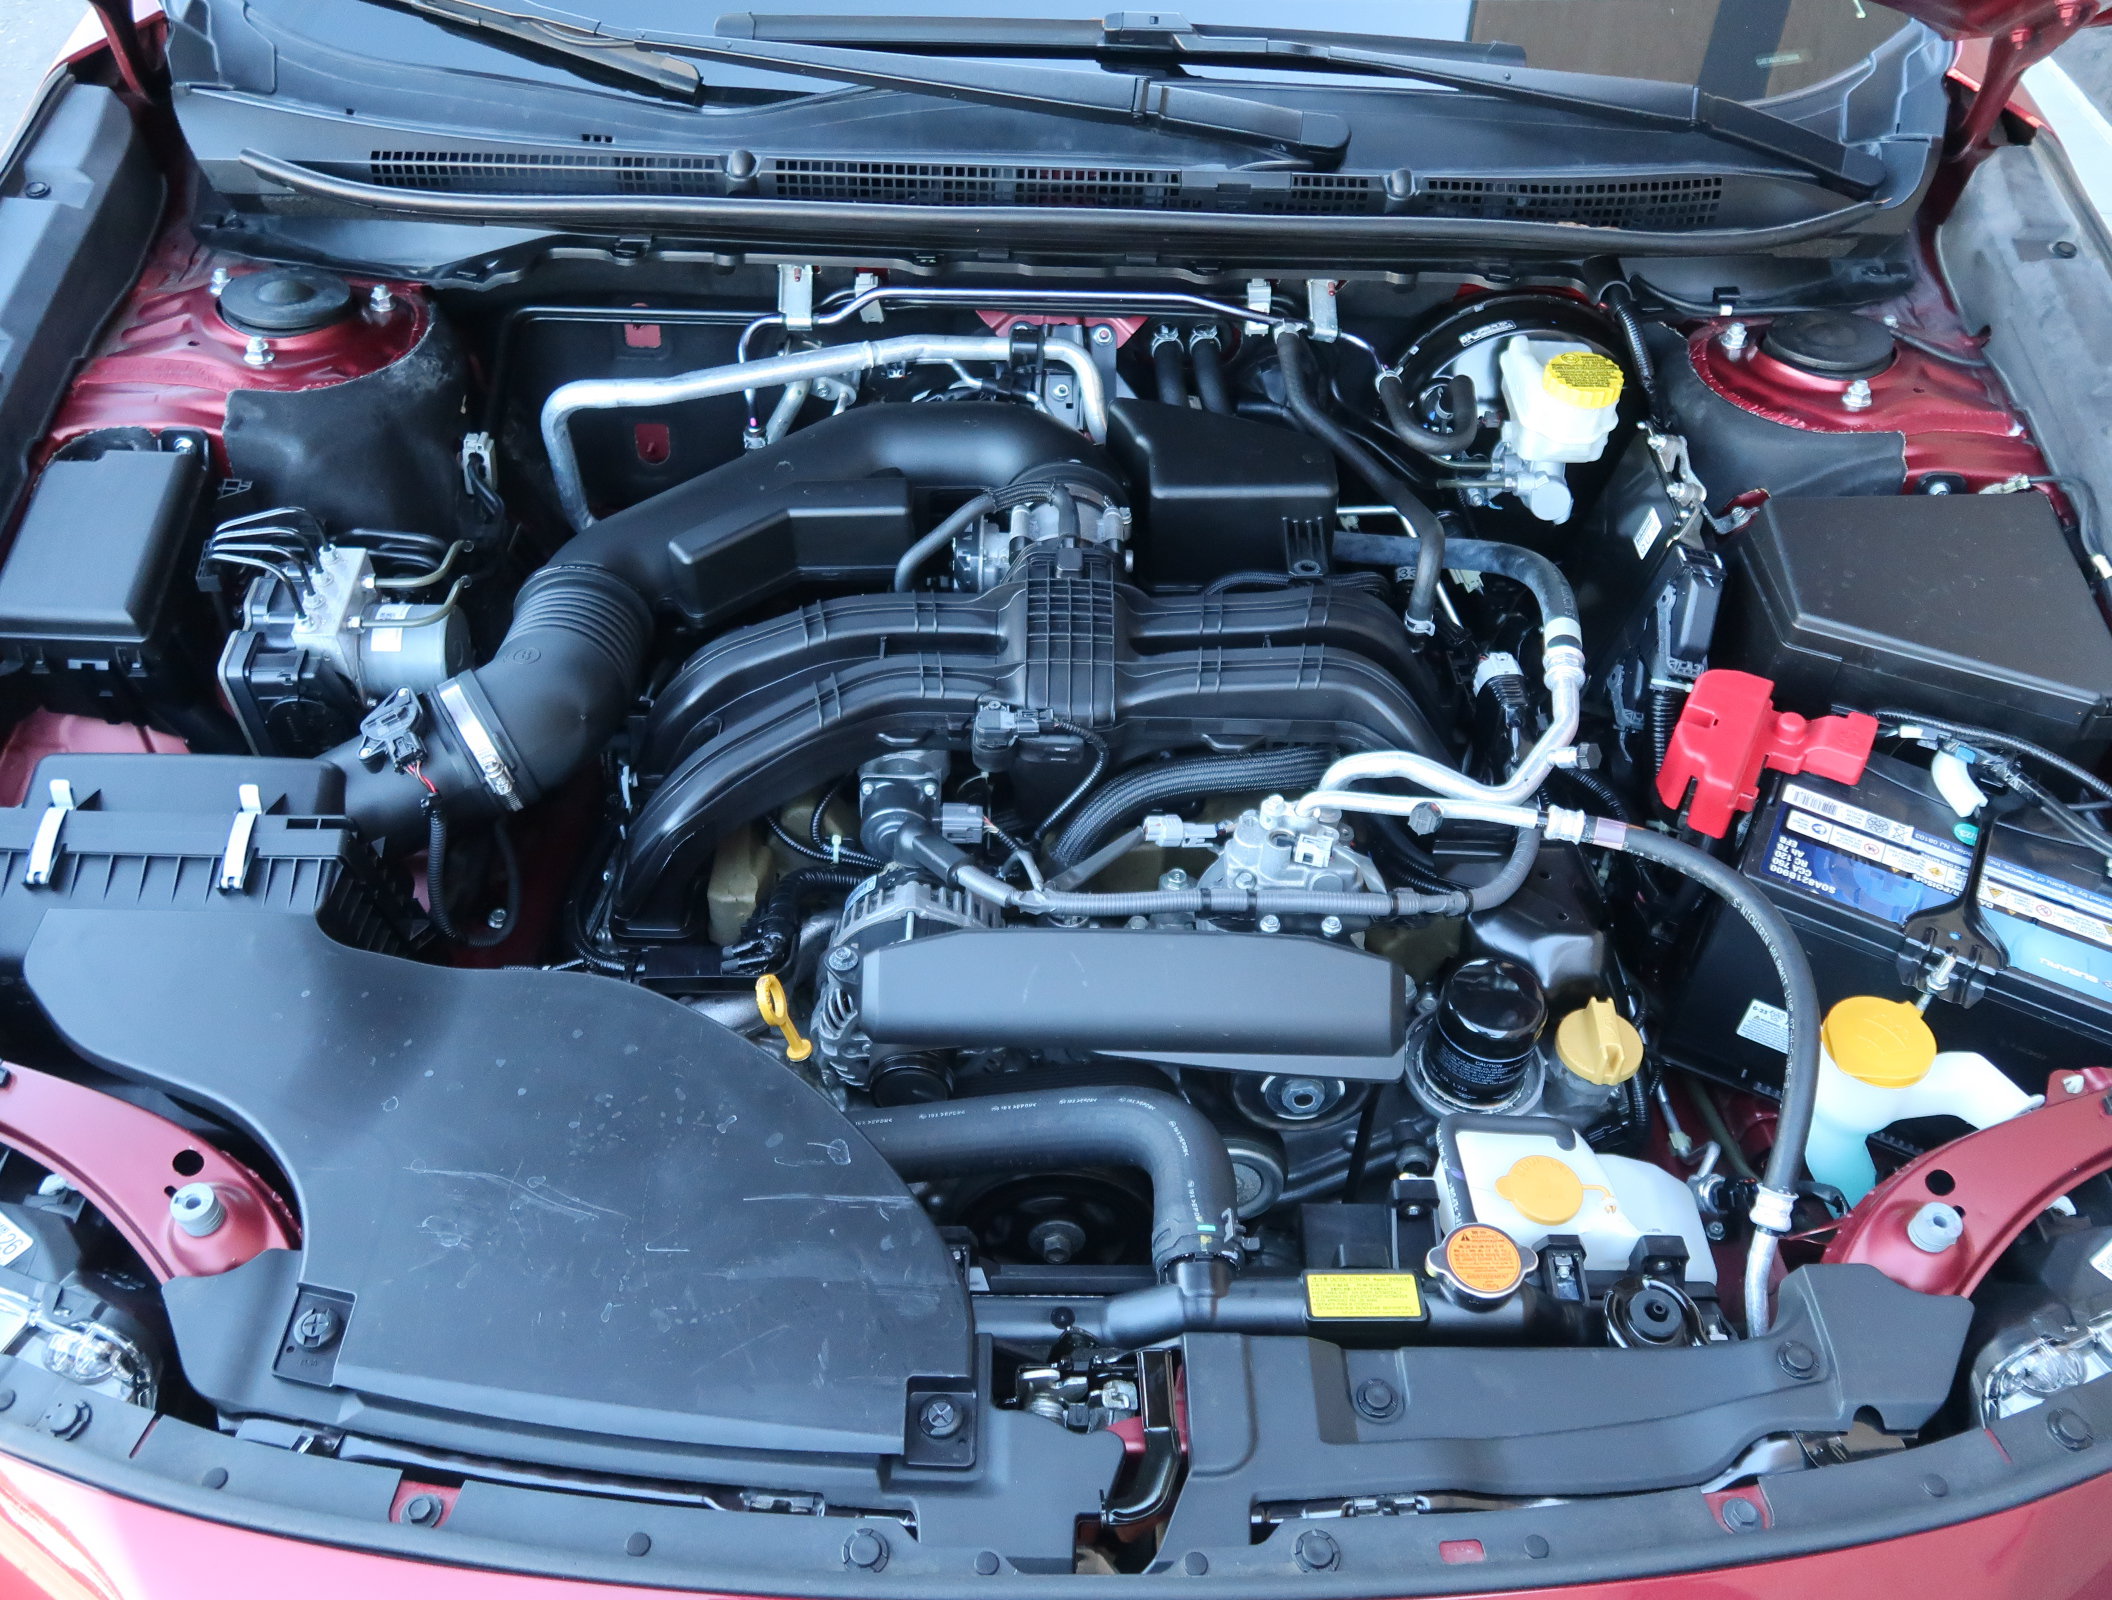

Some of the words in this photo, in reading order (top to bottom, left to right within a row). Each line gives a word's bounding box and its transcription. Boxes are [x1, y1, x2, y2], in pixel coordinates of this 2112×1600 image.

[1776, 842, 1789, 853] 76
[1779, 835, 1798, 848] EFB
[1774, 849, 1792, 862] 120
[1791, 848, 1805, 858] Ah
[1772, 857, 1790, 869] 750
[1794, 857, 1808, 868] RC
[1792, 864, 1812, 877] CCA
[2039, 956, 2099, 984] SUBARU
